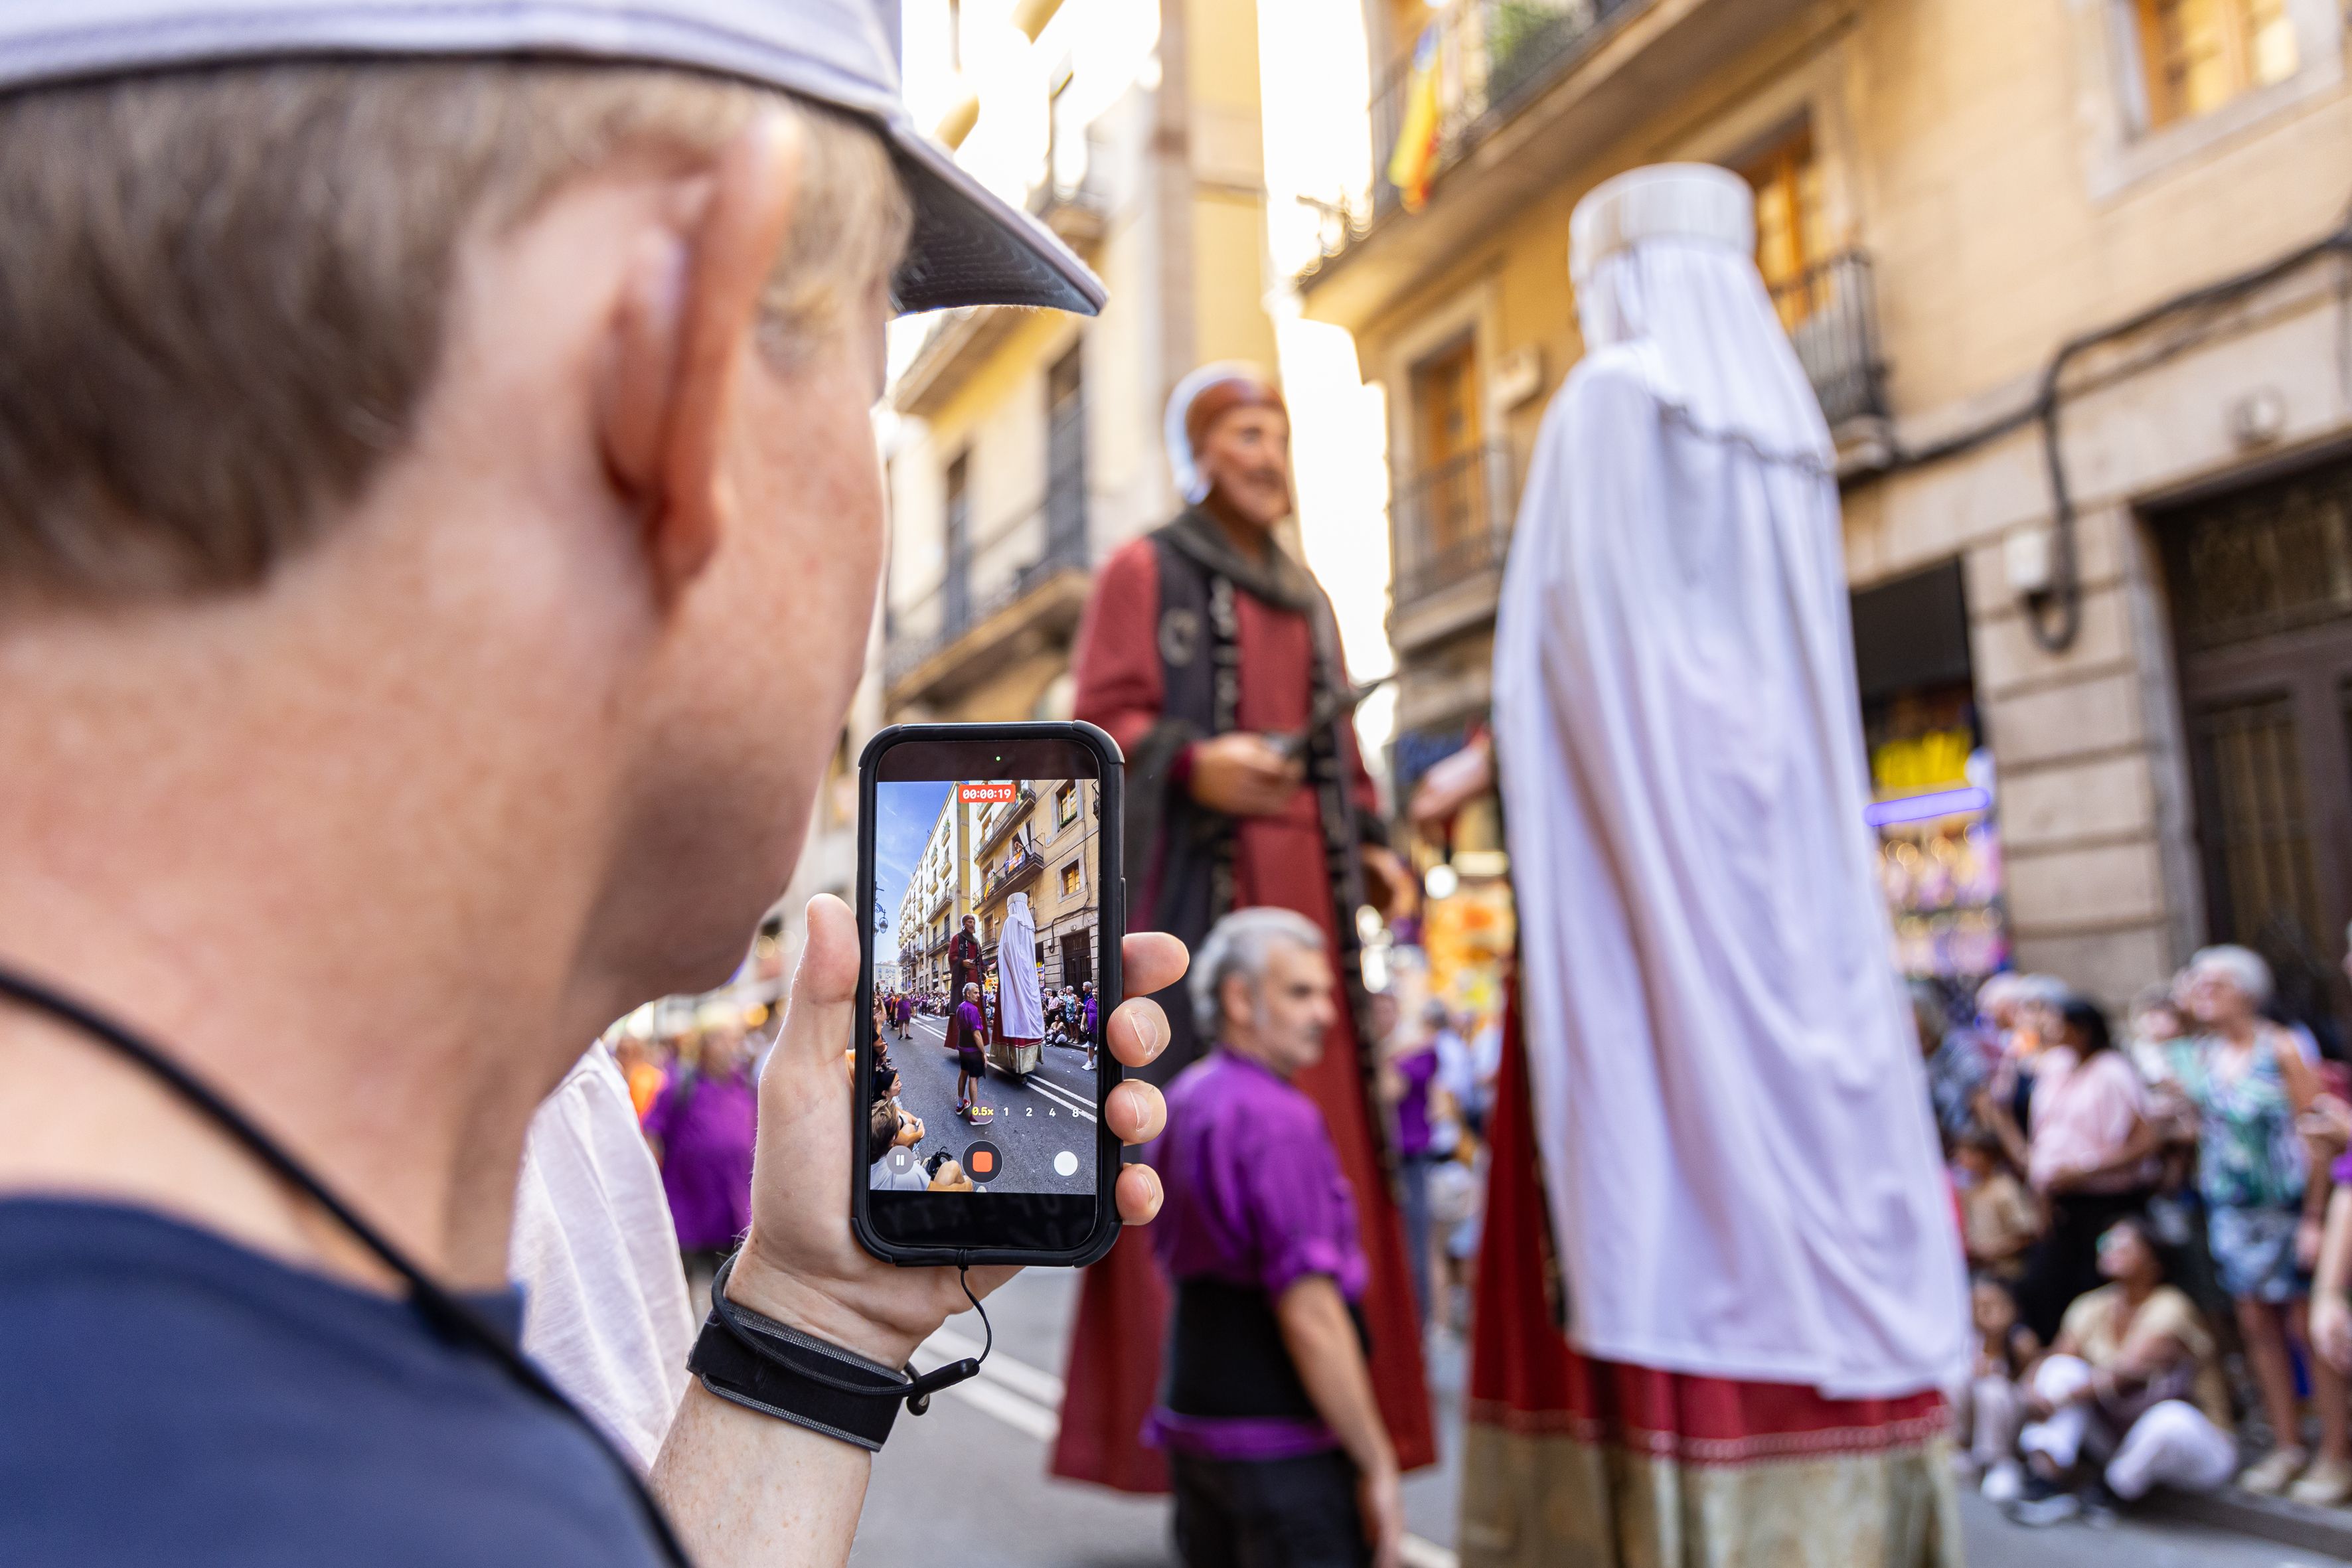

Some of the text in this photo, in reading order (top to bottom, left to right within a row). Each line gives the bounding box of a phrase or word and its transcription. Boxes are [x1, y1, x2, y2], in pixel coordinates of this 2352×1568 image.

[963, 789, 1011, 799] 00:00:19
[972, 1107, 1079, 1118] 0.5x 1 2 4 8
